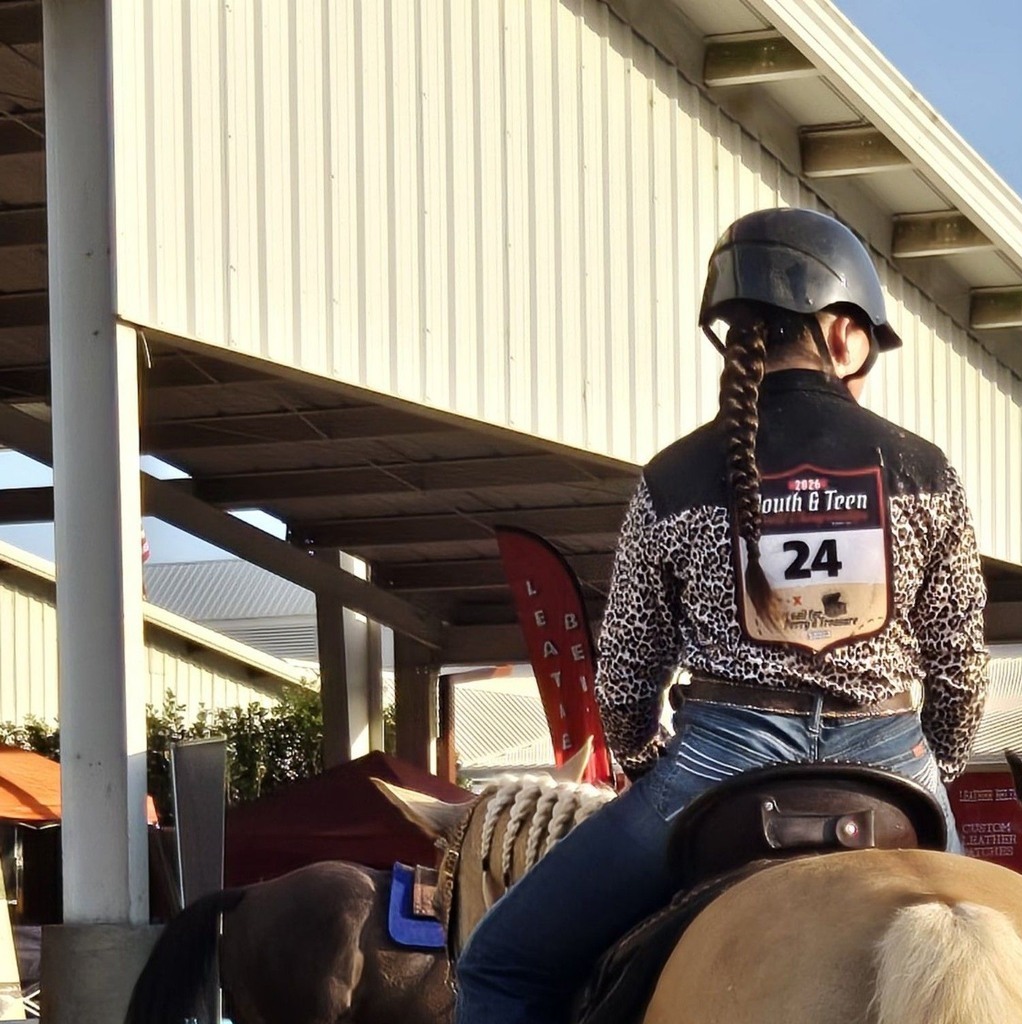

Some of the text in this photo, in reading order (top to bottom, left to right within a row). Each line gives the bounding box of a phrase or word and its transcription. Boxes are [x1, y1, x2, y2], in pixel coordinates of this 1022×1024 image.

[824, 489, 867, 511] Teen
[782, 538, 843, 581] 24
[962, 821, 1012, 834] CUSTOM
[966, 845, 1014, 857] ATCHES
